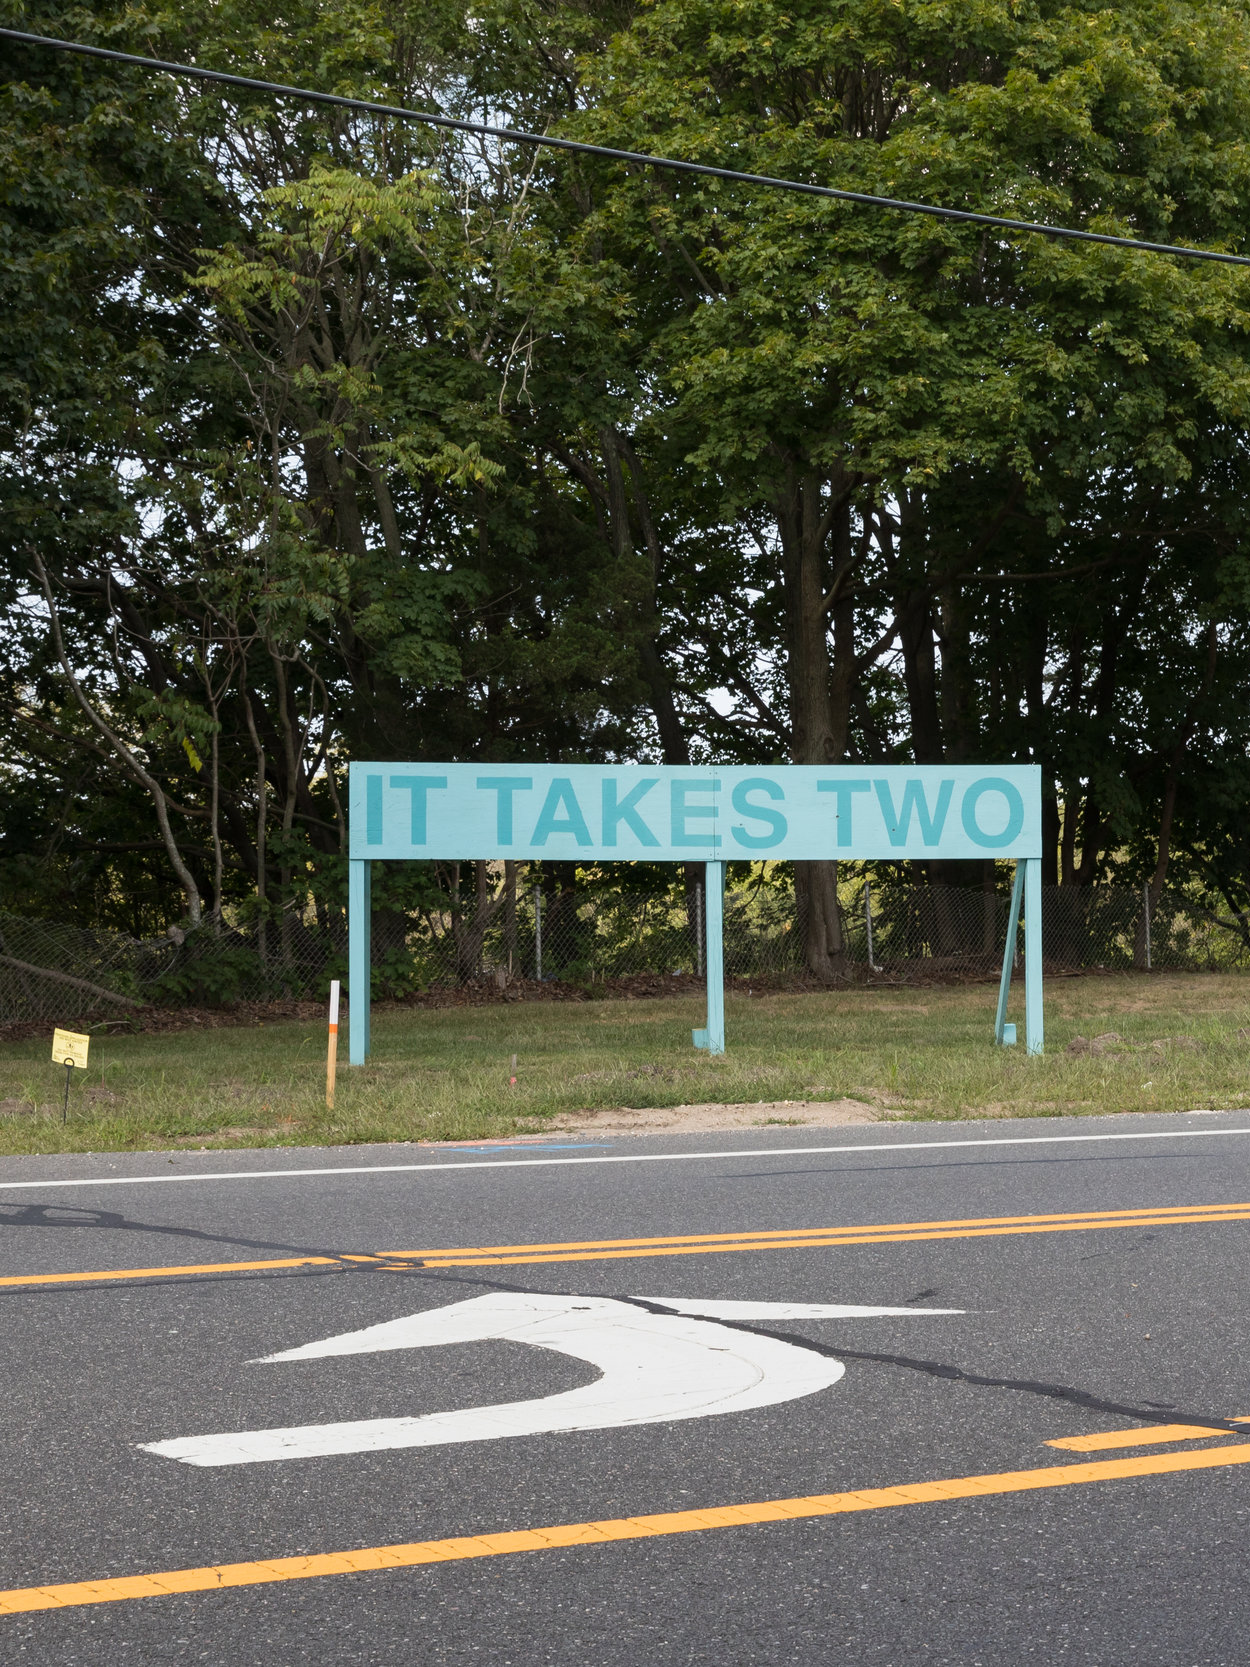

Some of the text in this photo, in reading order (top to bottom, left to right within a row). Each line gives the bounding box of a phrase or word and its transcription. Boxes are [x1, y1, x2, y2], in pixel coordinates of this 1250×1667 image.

[366, 775, 1024, 849] IT TAKES TWO
